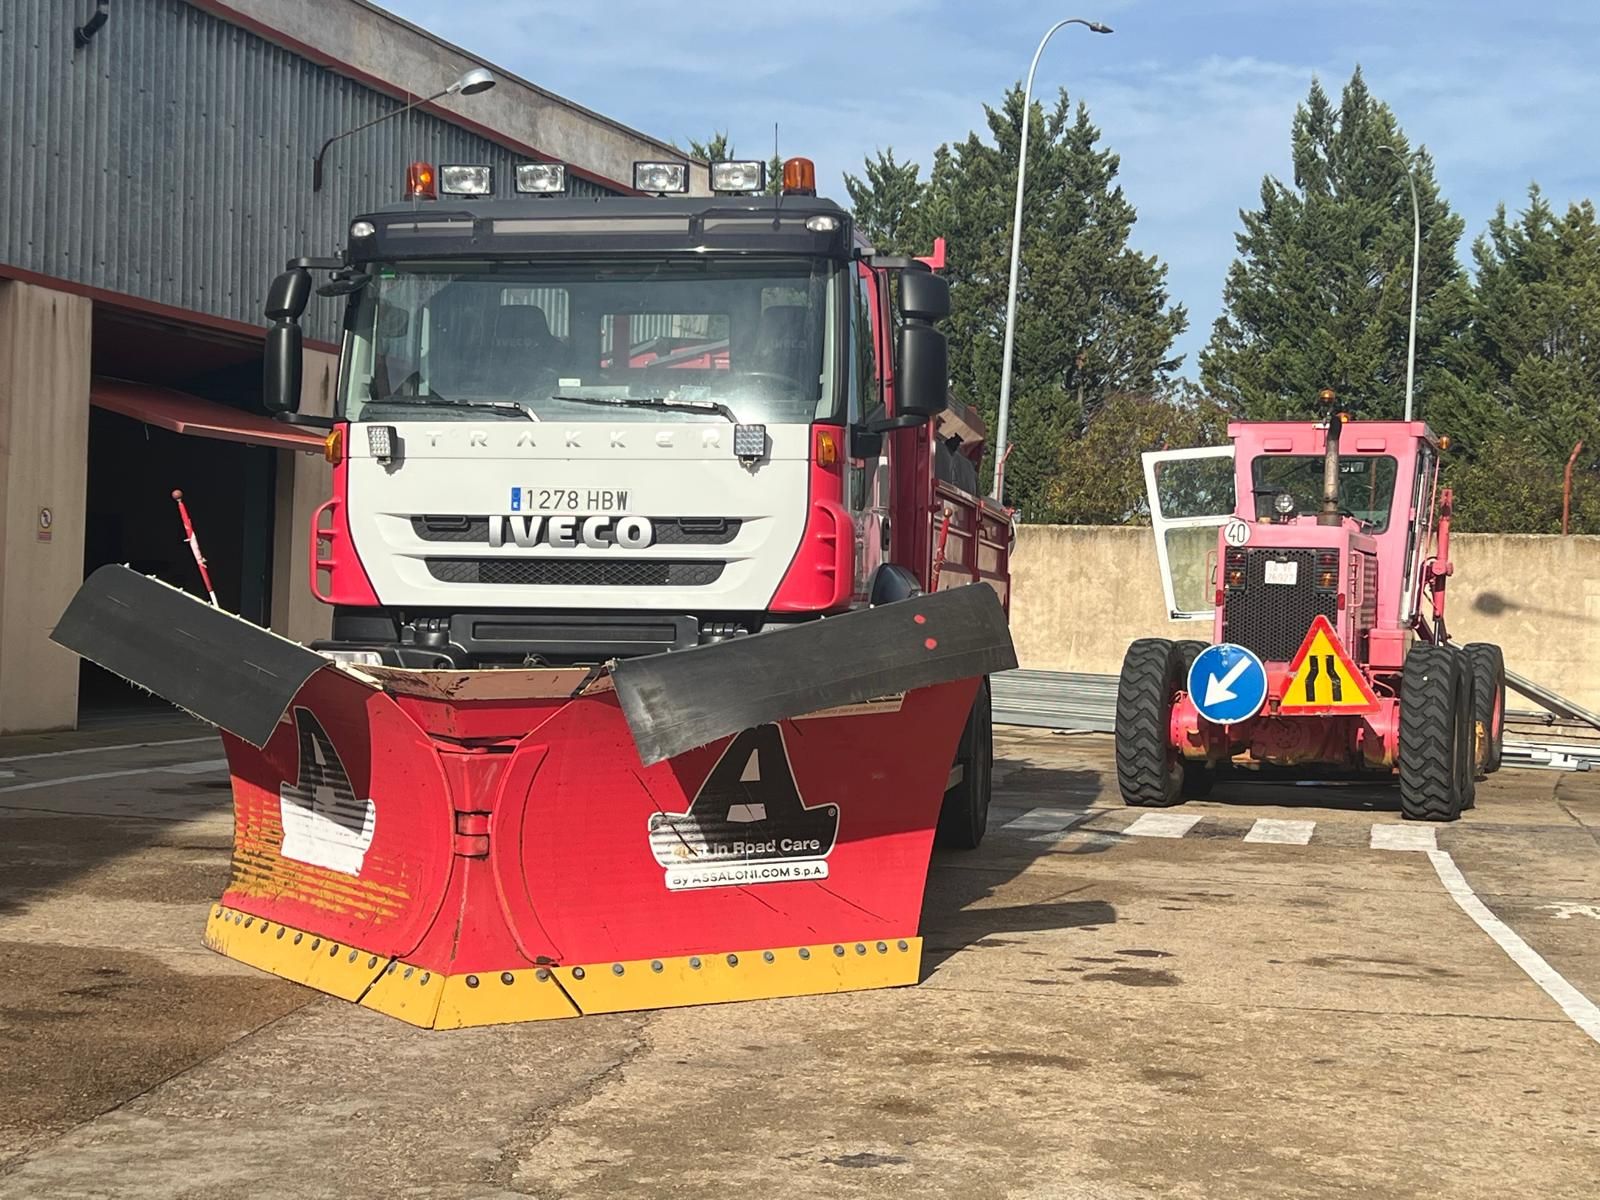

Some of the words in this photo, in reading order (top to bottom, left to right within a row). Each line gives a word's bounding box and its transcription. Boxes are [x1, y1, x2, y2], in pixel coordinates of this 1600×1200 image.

[425, 428, 721, 448] TRAKKER
[526, 489, 579, 511] 1278
[587, 489, 628, 511] HBW
[488, 515, 653, 549] IVECO
[1227, 523, 1246, 543] 40
[714, 842, 730, 855] in
[732, 840, 776, 855] Road
[780, 838, 820, 852] Care
[691, 867, 790, 884] ASSALONI.COM
